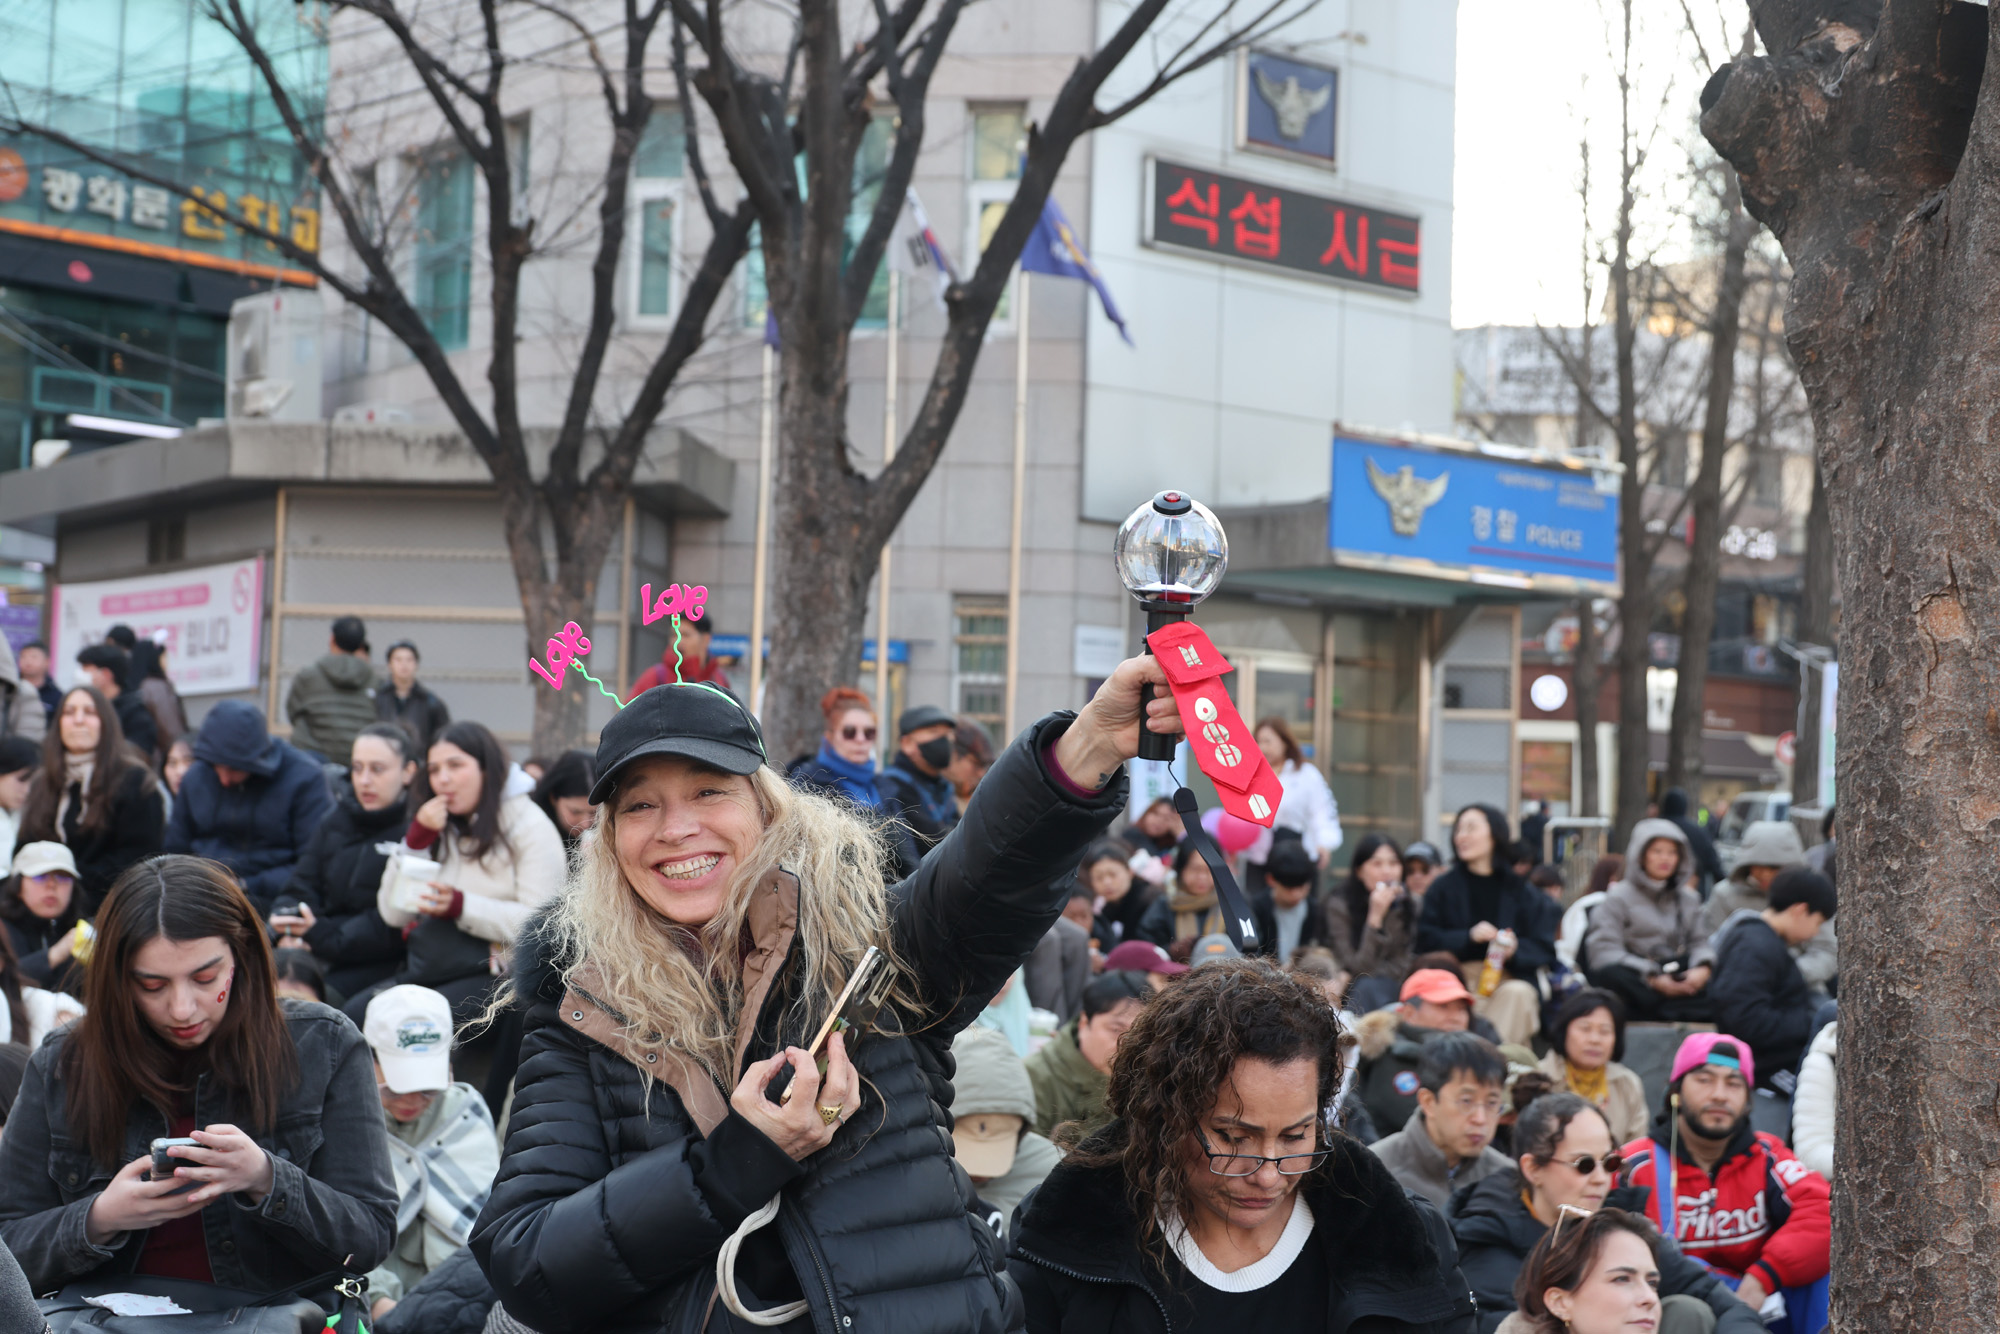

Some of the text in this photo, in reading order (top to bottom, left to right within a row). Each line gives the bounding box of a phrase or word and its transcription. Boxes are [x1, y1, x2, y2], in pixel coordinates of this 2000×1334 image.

[42, 168, 169, 229] 광화문
[1525, 523, 1583, 551] POLICE
[640, 583, 708, 626] Love
[529, 621, 592, 690] Love
